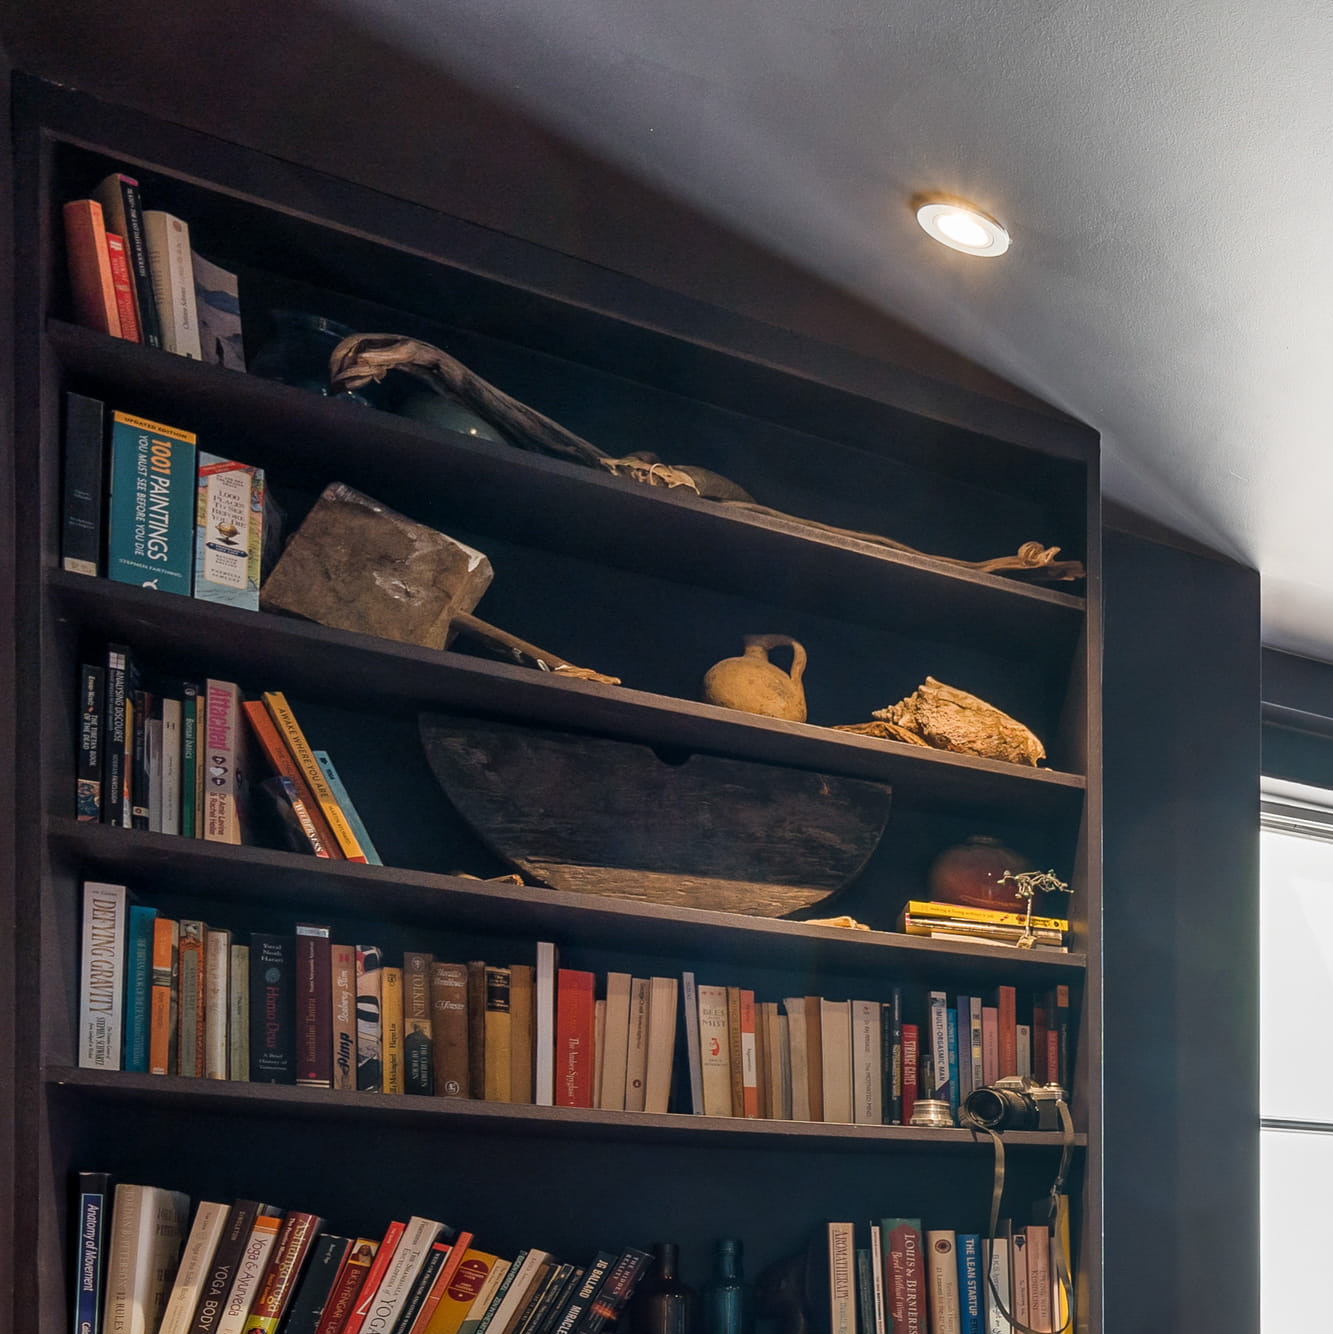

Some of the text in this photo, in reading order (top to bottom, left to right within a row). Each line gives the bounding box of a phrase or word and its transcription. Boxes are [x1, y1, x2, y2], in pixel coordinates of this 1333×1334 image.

[134, 435, 148, 556] YOU MUST SEE BEFORE YOU DIE
[147, 439, 171, 562] 1001 PAINTINGS
[208, 686, 232, 751] Attached
[89, 898, 116, 1016] DEFYING GRAVITY
[413, 974, 424, 1017] TOLKIEN
[83, 1204, 99, 1292] Anatomy of Movement
[598, 1260, 608, 1270] JG
[965, 1238, 975, 1252] THE
[966, 1255, 975, 1275] LEAN
[198, 1265, 230, 1331] YOGA BODY
[227, 1238, 267, 1317] Yoga & Ayurveda
[579, 1269, 604, 1298] BALLARD
[967, 1277, 977, 1316] STARTUP
[969, 1319, 978, 1334] ERIC
